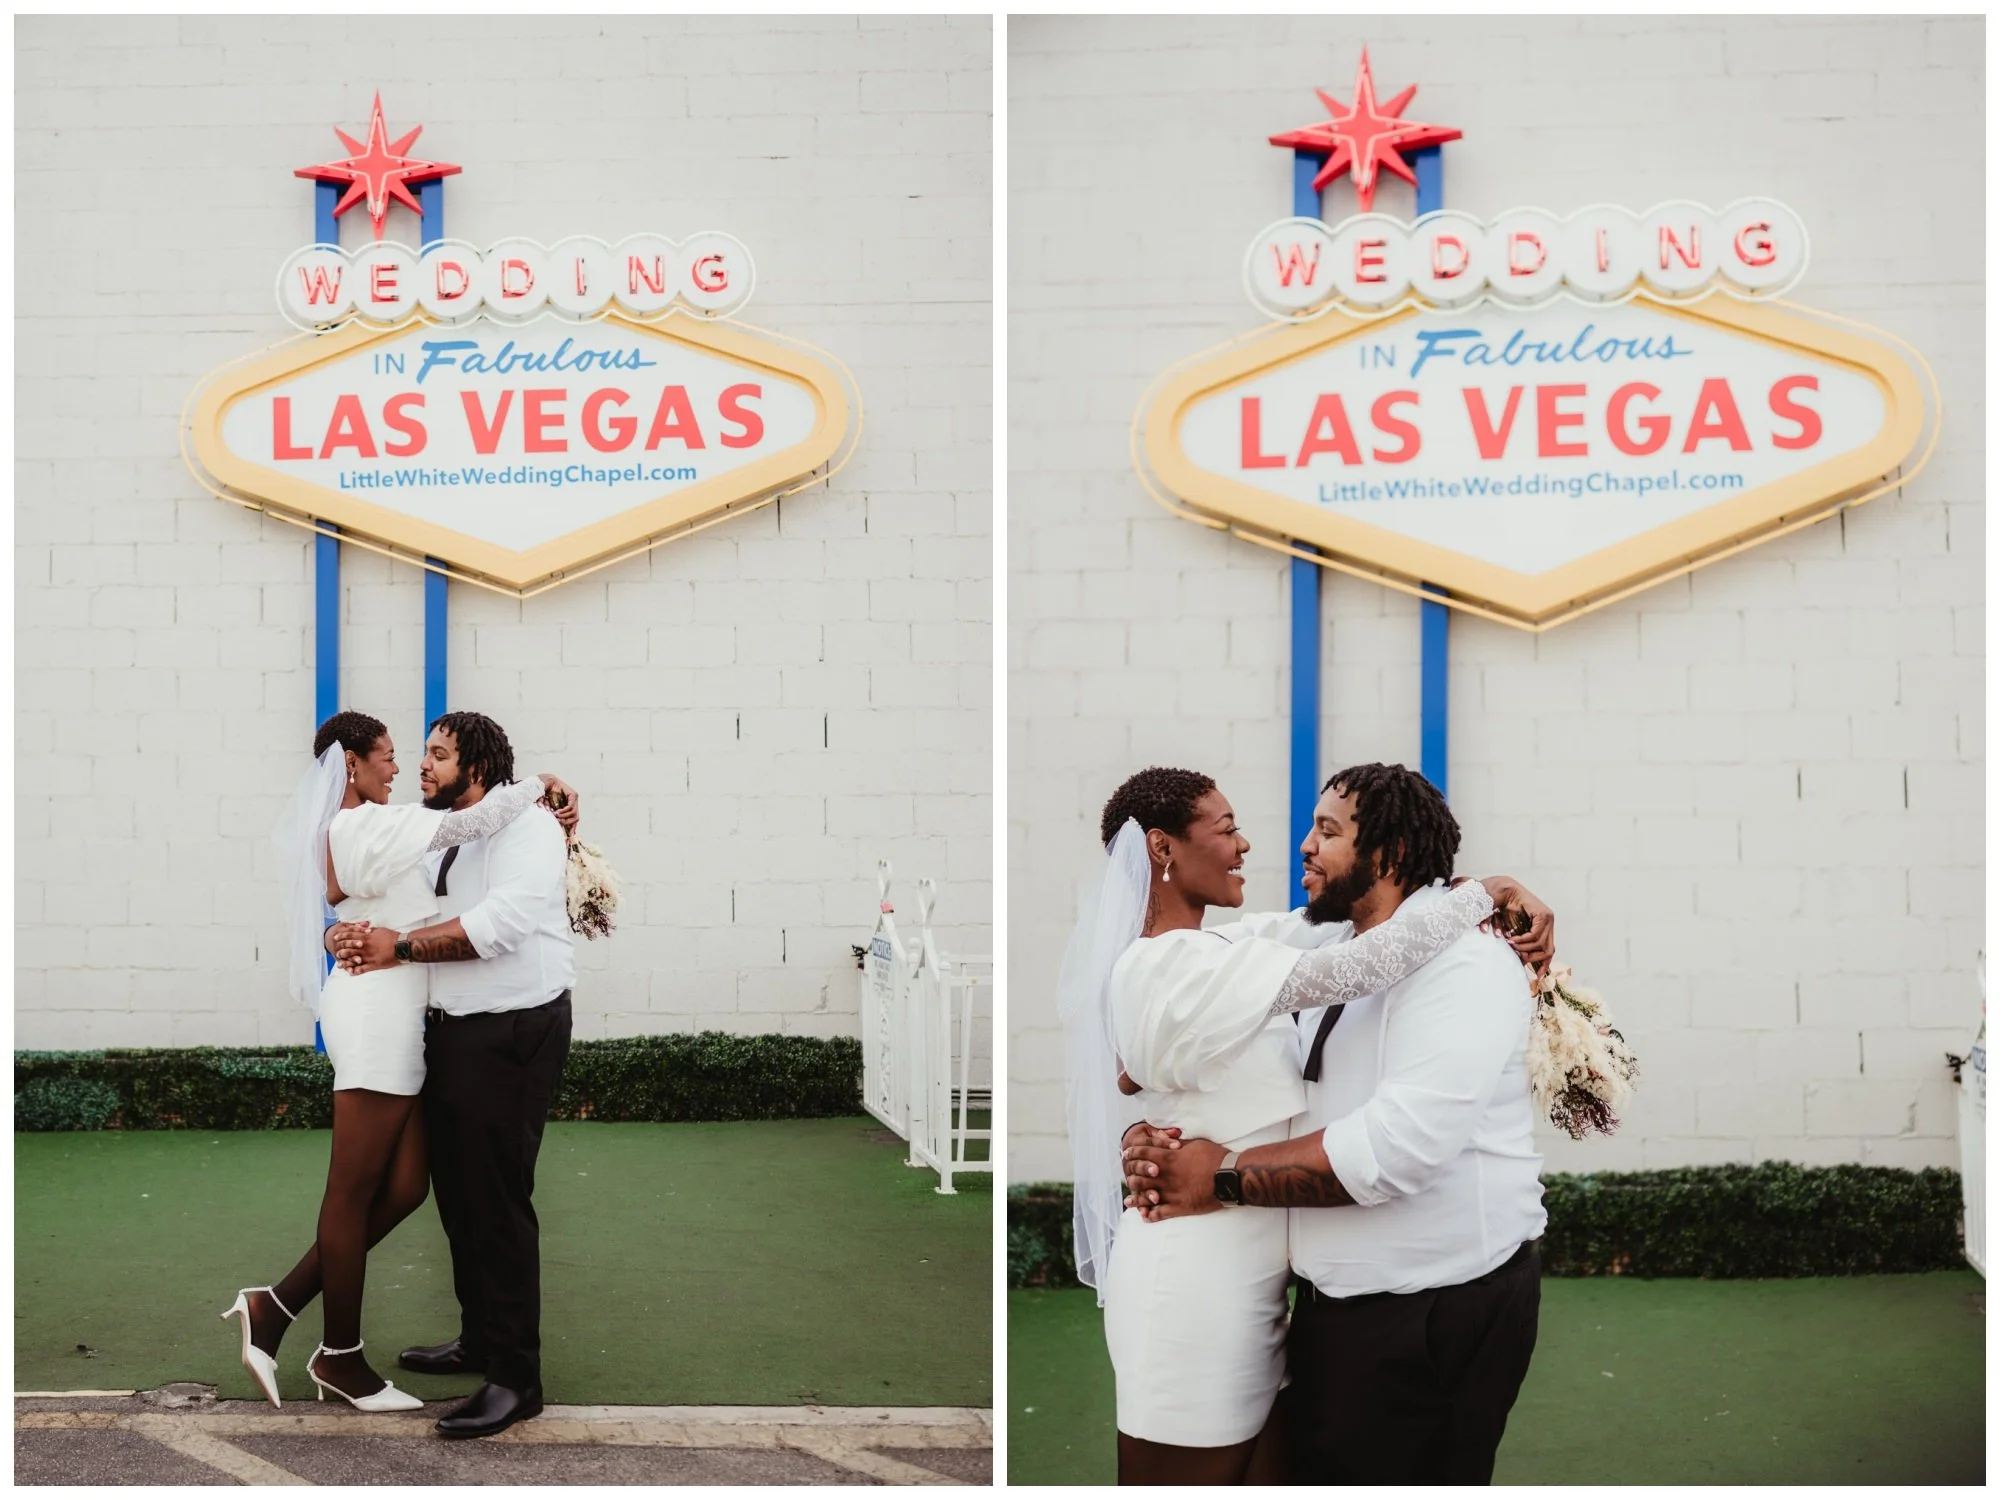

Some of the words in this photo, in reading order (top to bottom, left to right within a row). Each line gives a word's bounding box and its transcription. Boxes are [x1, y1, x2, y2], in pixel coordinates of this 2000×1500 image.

[299, 254, 729, 305] WEDDING
[1271, 221, 1778, 287] WEDDING
[373, 352, 406, 375] IN
[416, 337, 657, 384] Fabulous
[1360, 345, 1396, 369] IN
[1410, 323, 1694, 378] Fabulous
[272, 391, 429, 461] LAS
[460, 382, 765, 456] VEGAS
[1240, 390, 1422, 470] LAS
[1462, 375, 1823, 461] VEGAS
[339, 463, 697, 490] LittleWhiteWeddingChapel.com
[1319, 470, 1744, 503] LittleWhiteWeddingChapel.com
